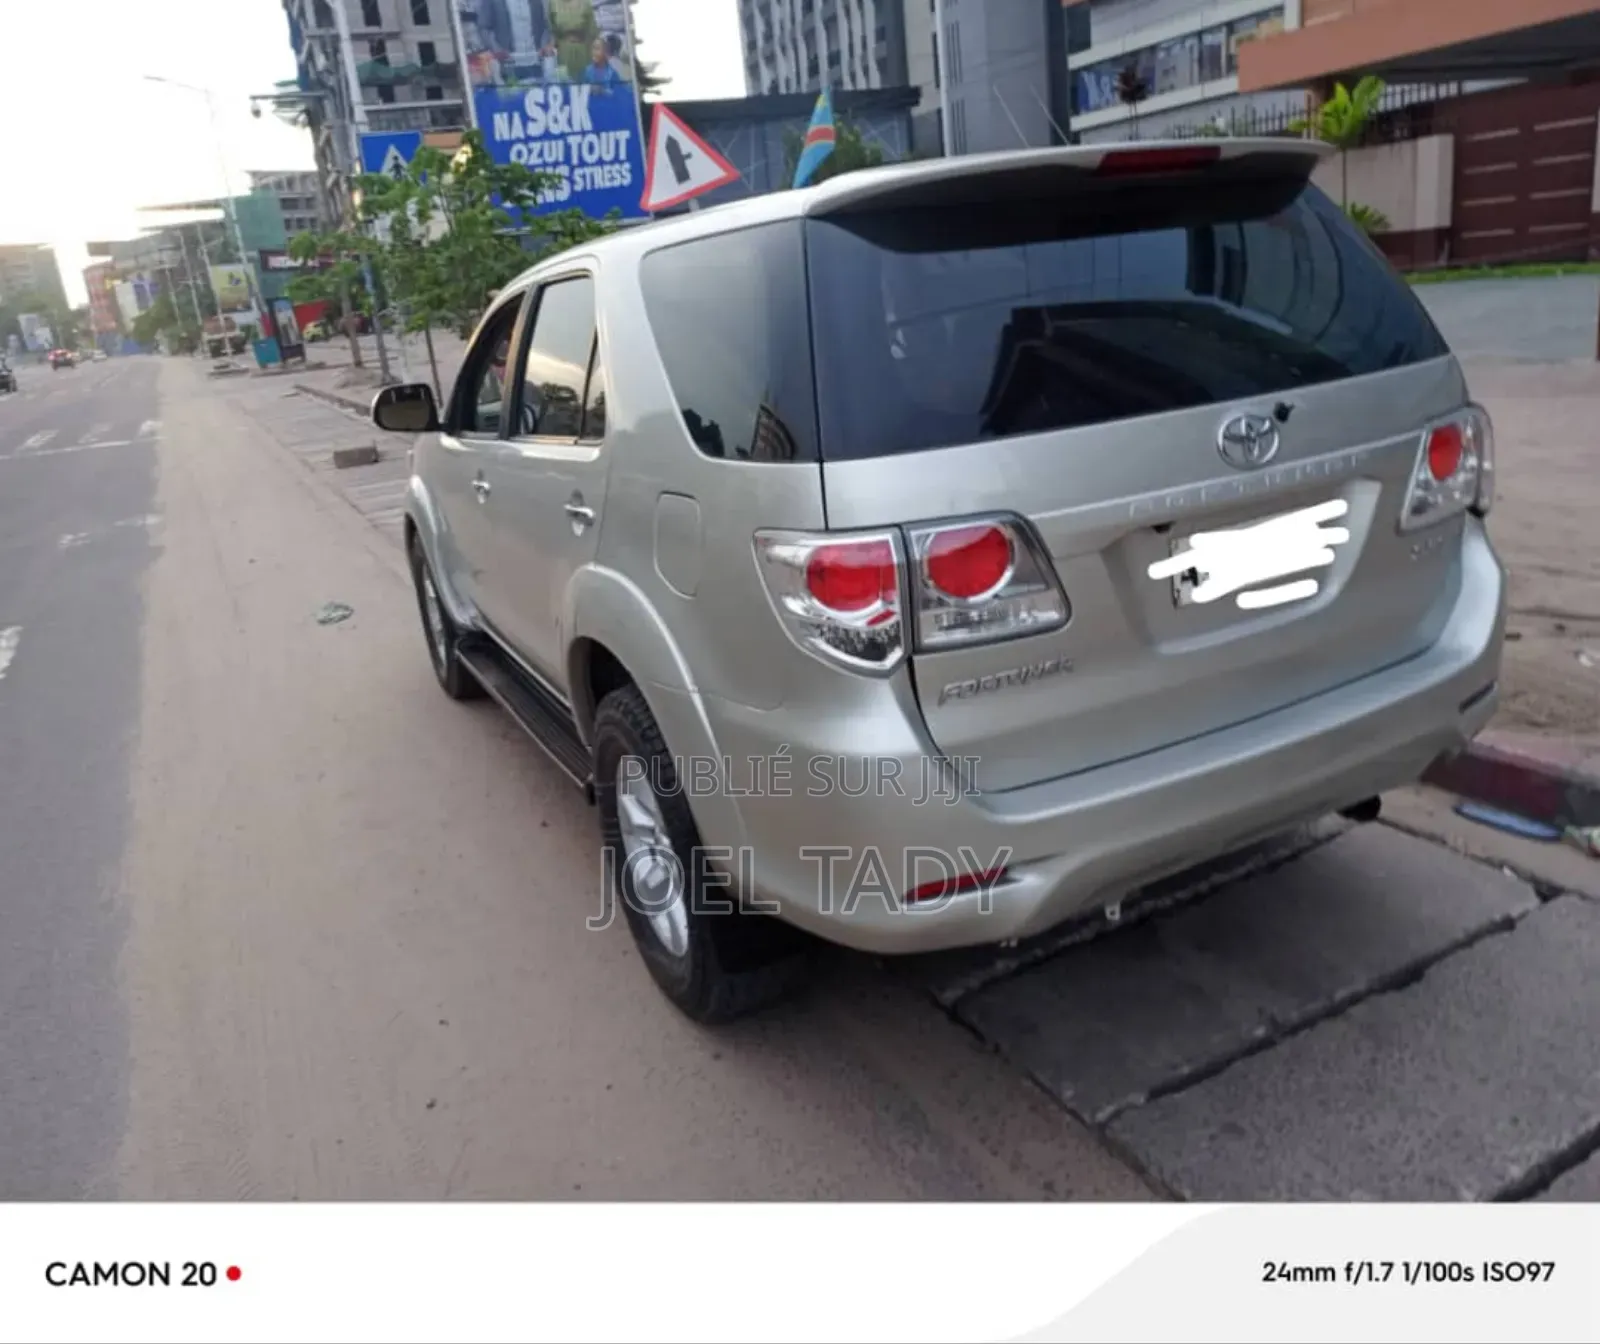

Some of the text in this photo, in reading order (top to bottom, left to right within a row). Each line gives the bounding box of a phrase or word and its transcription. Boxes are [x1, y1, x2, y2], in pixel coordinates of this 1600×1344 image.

[493, 84, 592, 141] NA S&K
[510, 130, 630, 165] OZUI TOUT
[573, 162, 632, 191] STRESS
